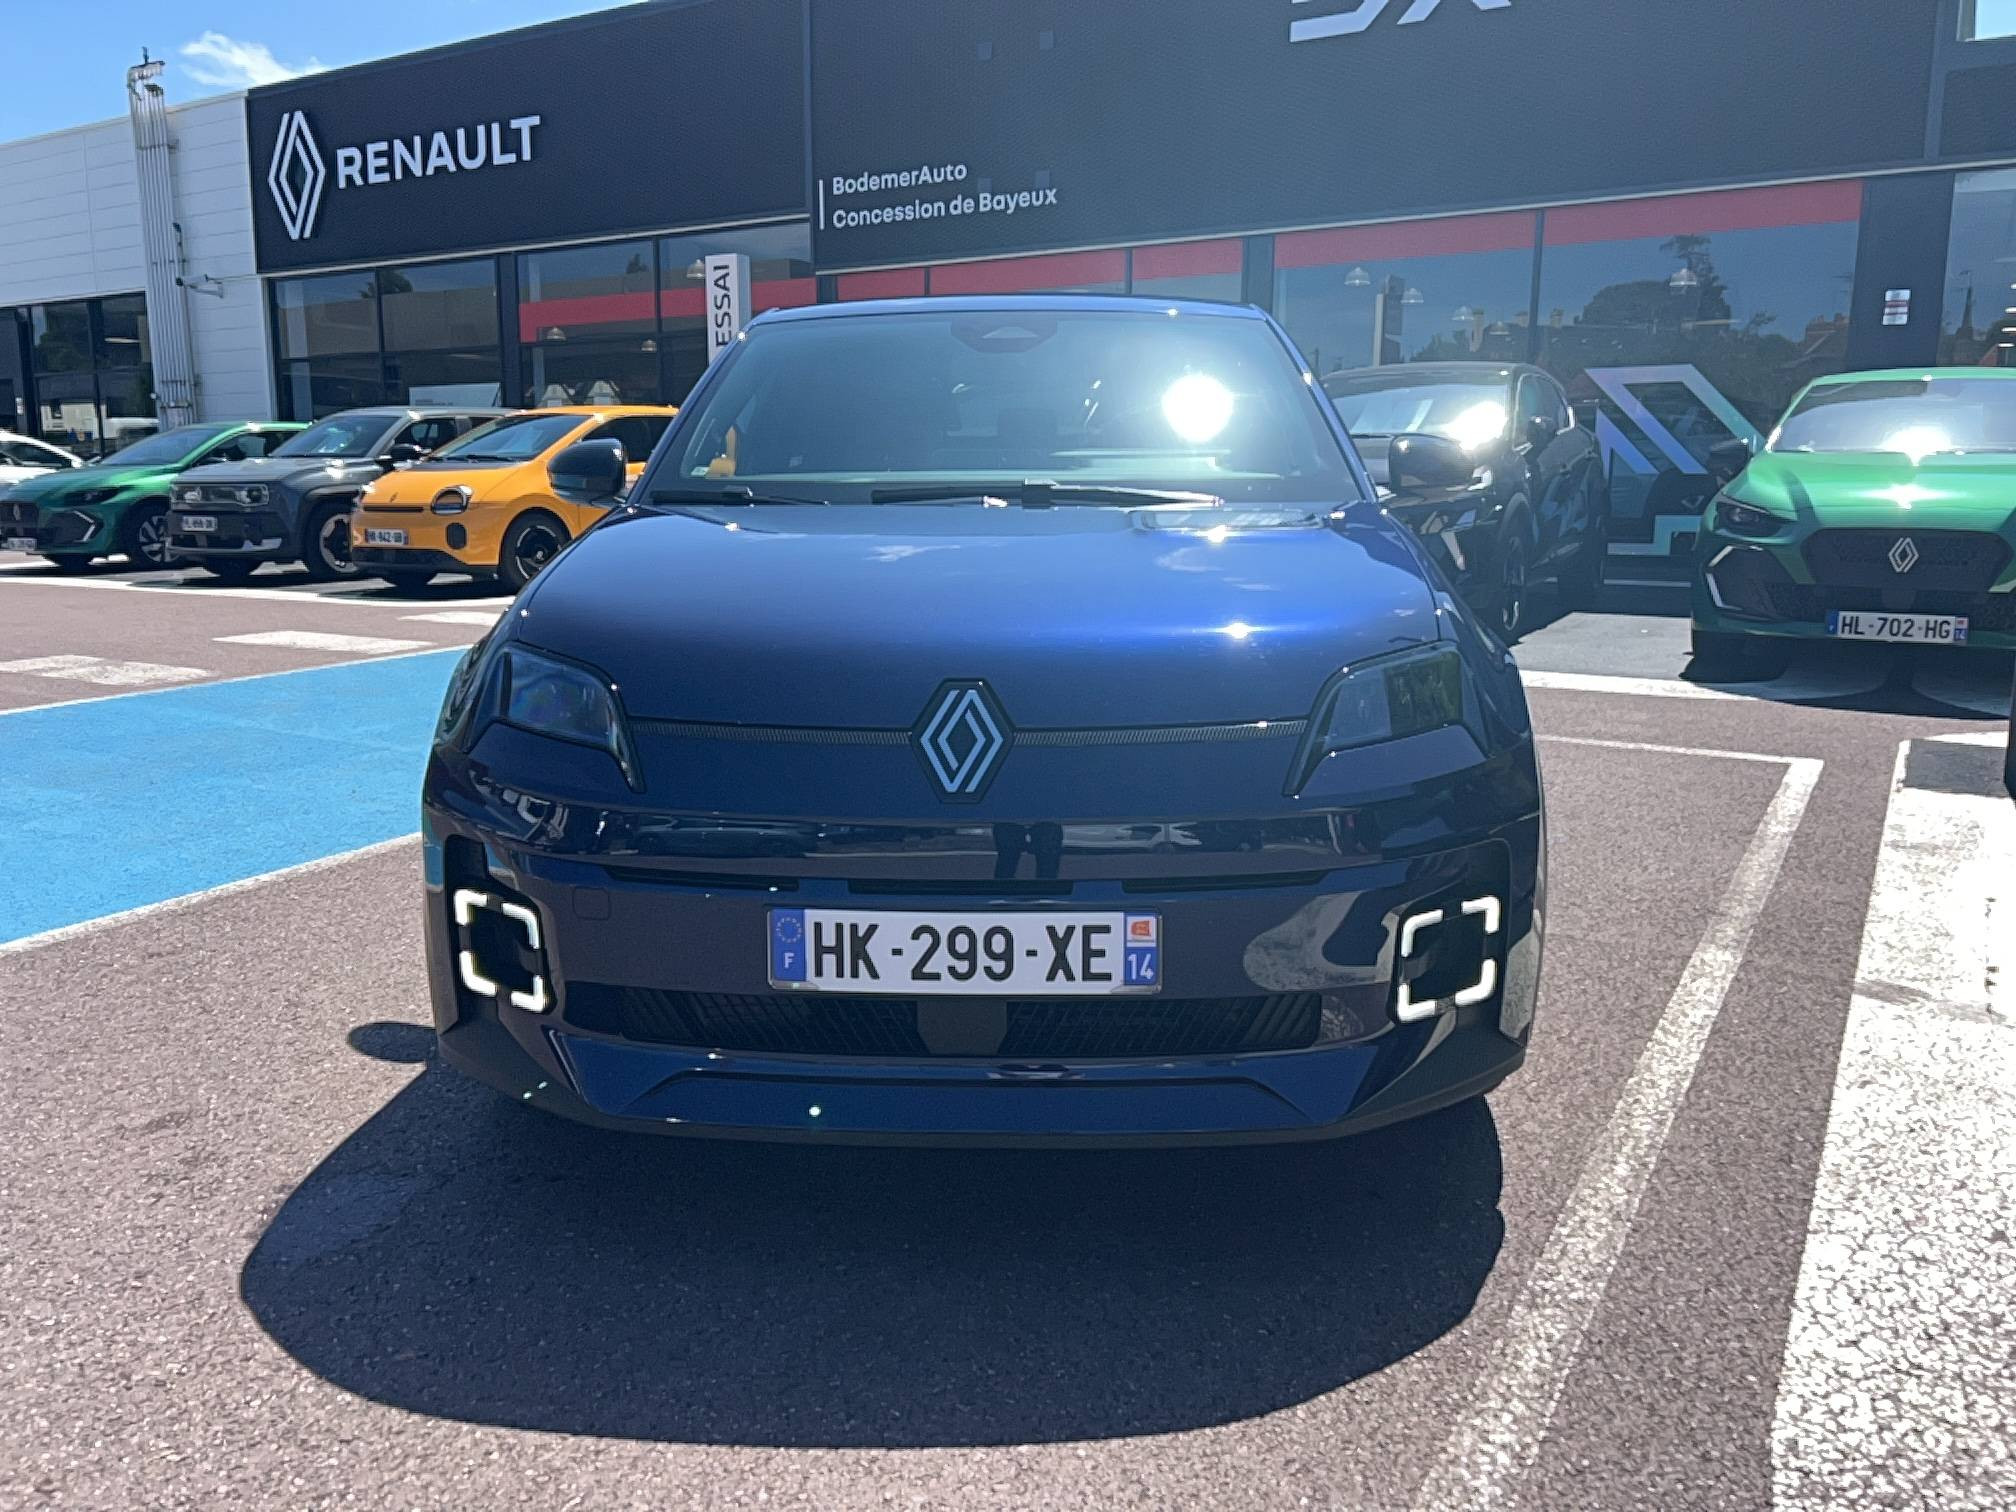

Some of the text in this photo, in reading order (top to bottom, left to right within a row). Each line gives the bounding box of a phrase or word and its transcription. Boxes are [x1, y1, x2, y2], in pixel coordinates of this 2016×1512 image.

[336, 114, 541, 189] RENAULT
[832, 163, 968, 196] BodemerAuto
[832, 187, 1058, 229] Concession de Bayeux
[713, 264, 732, 347] ESSAI
[1841, 615, 1951, 639] HL-702-HG
[784, 952, 795, 969] F
[812, 921, 1113, 982] HK-299-XE
[1127, 953, 1154, 980] 14
